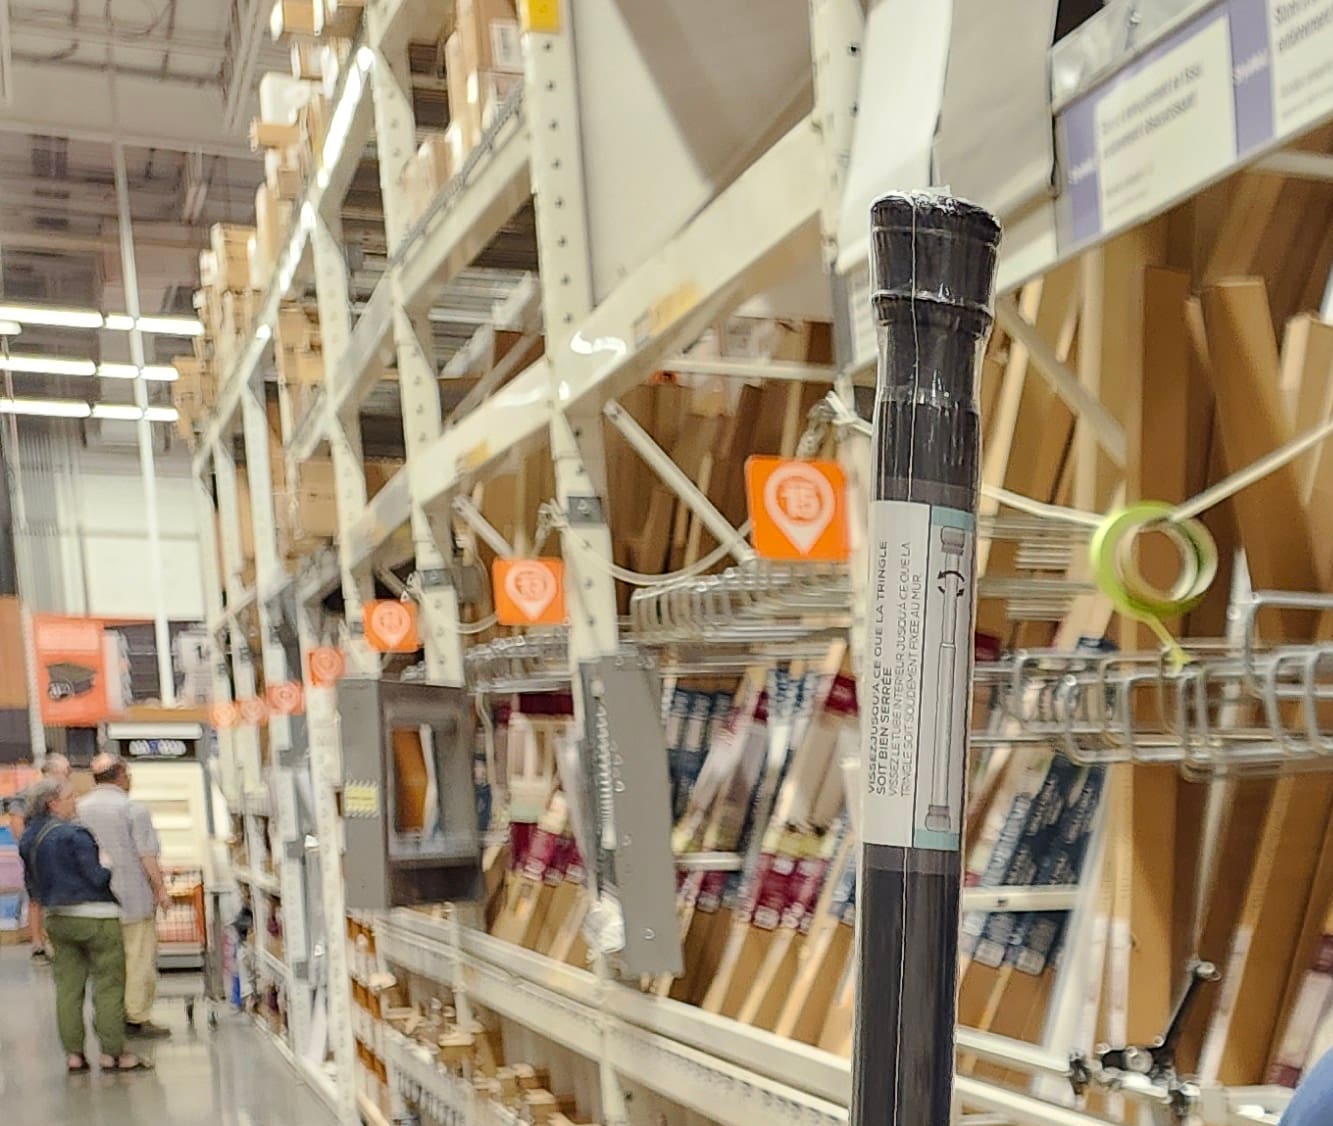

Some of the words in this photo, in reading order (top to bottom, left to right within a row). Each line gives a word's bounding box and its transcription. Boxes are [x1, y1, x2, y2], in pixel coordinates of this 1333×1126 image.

[877, 540, 888, 601] TRINGLE
[876, 605, 884, 624] LA
[874, 628, 883, 658] QUE
[880, 667, 892, 724] SERRÉE
[879, 727, 889, 760] BIEN
[877, 763, 888, 795] SOIT
